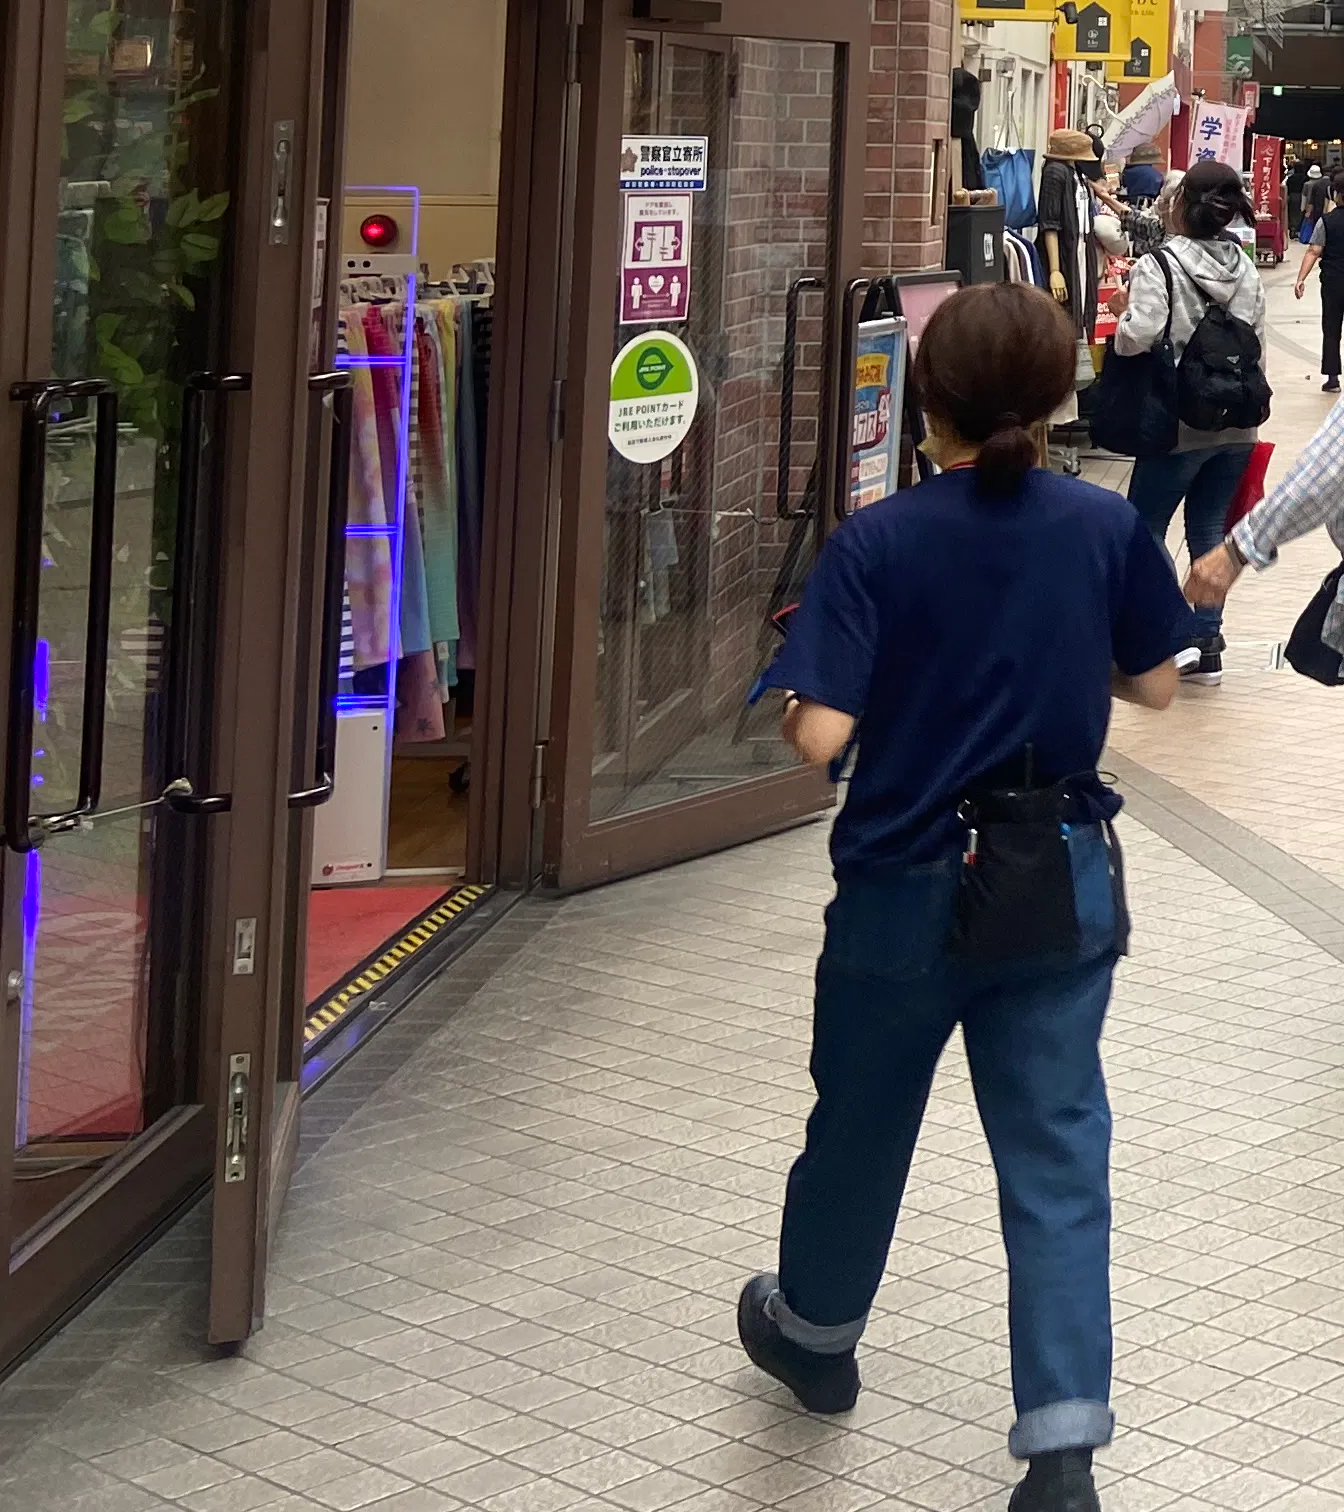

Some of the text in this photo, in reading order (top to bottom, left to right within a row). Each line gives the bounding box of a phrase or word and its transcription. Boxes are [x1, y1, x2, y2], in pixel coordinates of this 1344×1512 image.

[640, 145, 703, 162] 警察官立寄所
[619, 407, 634, 417] JRE
